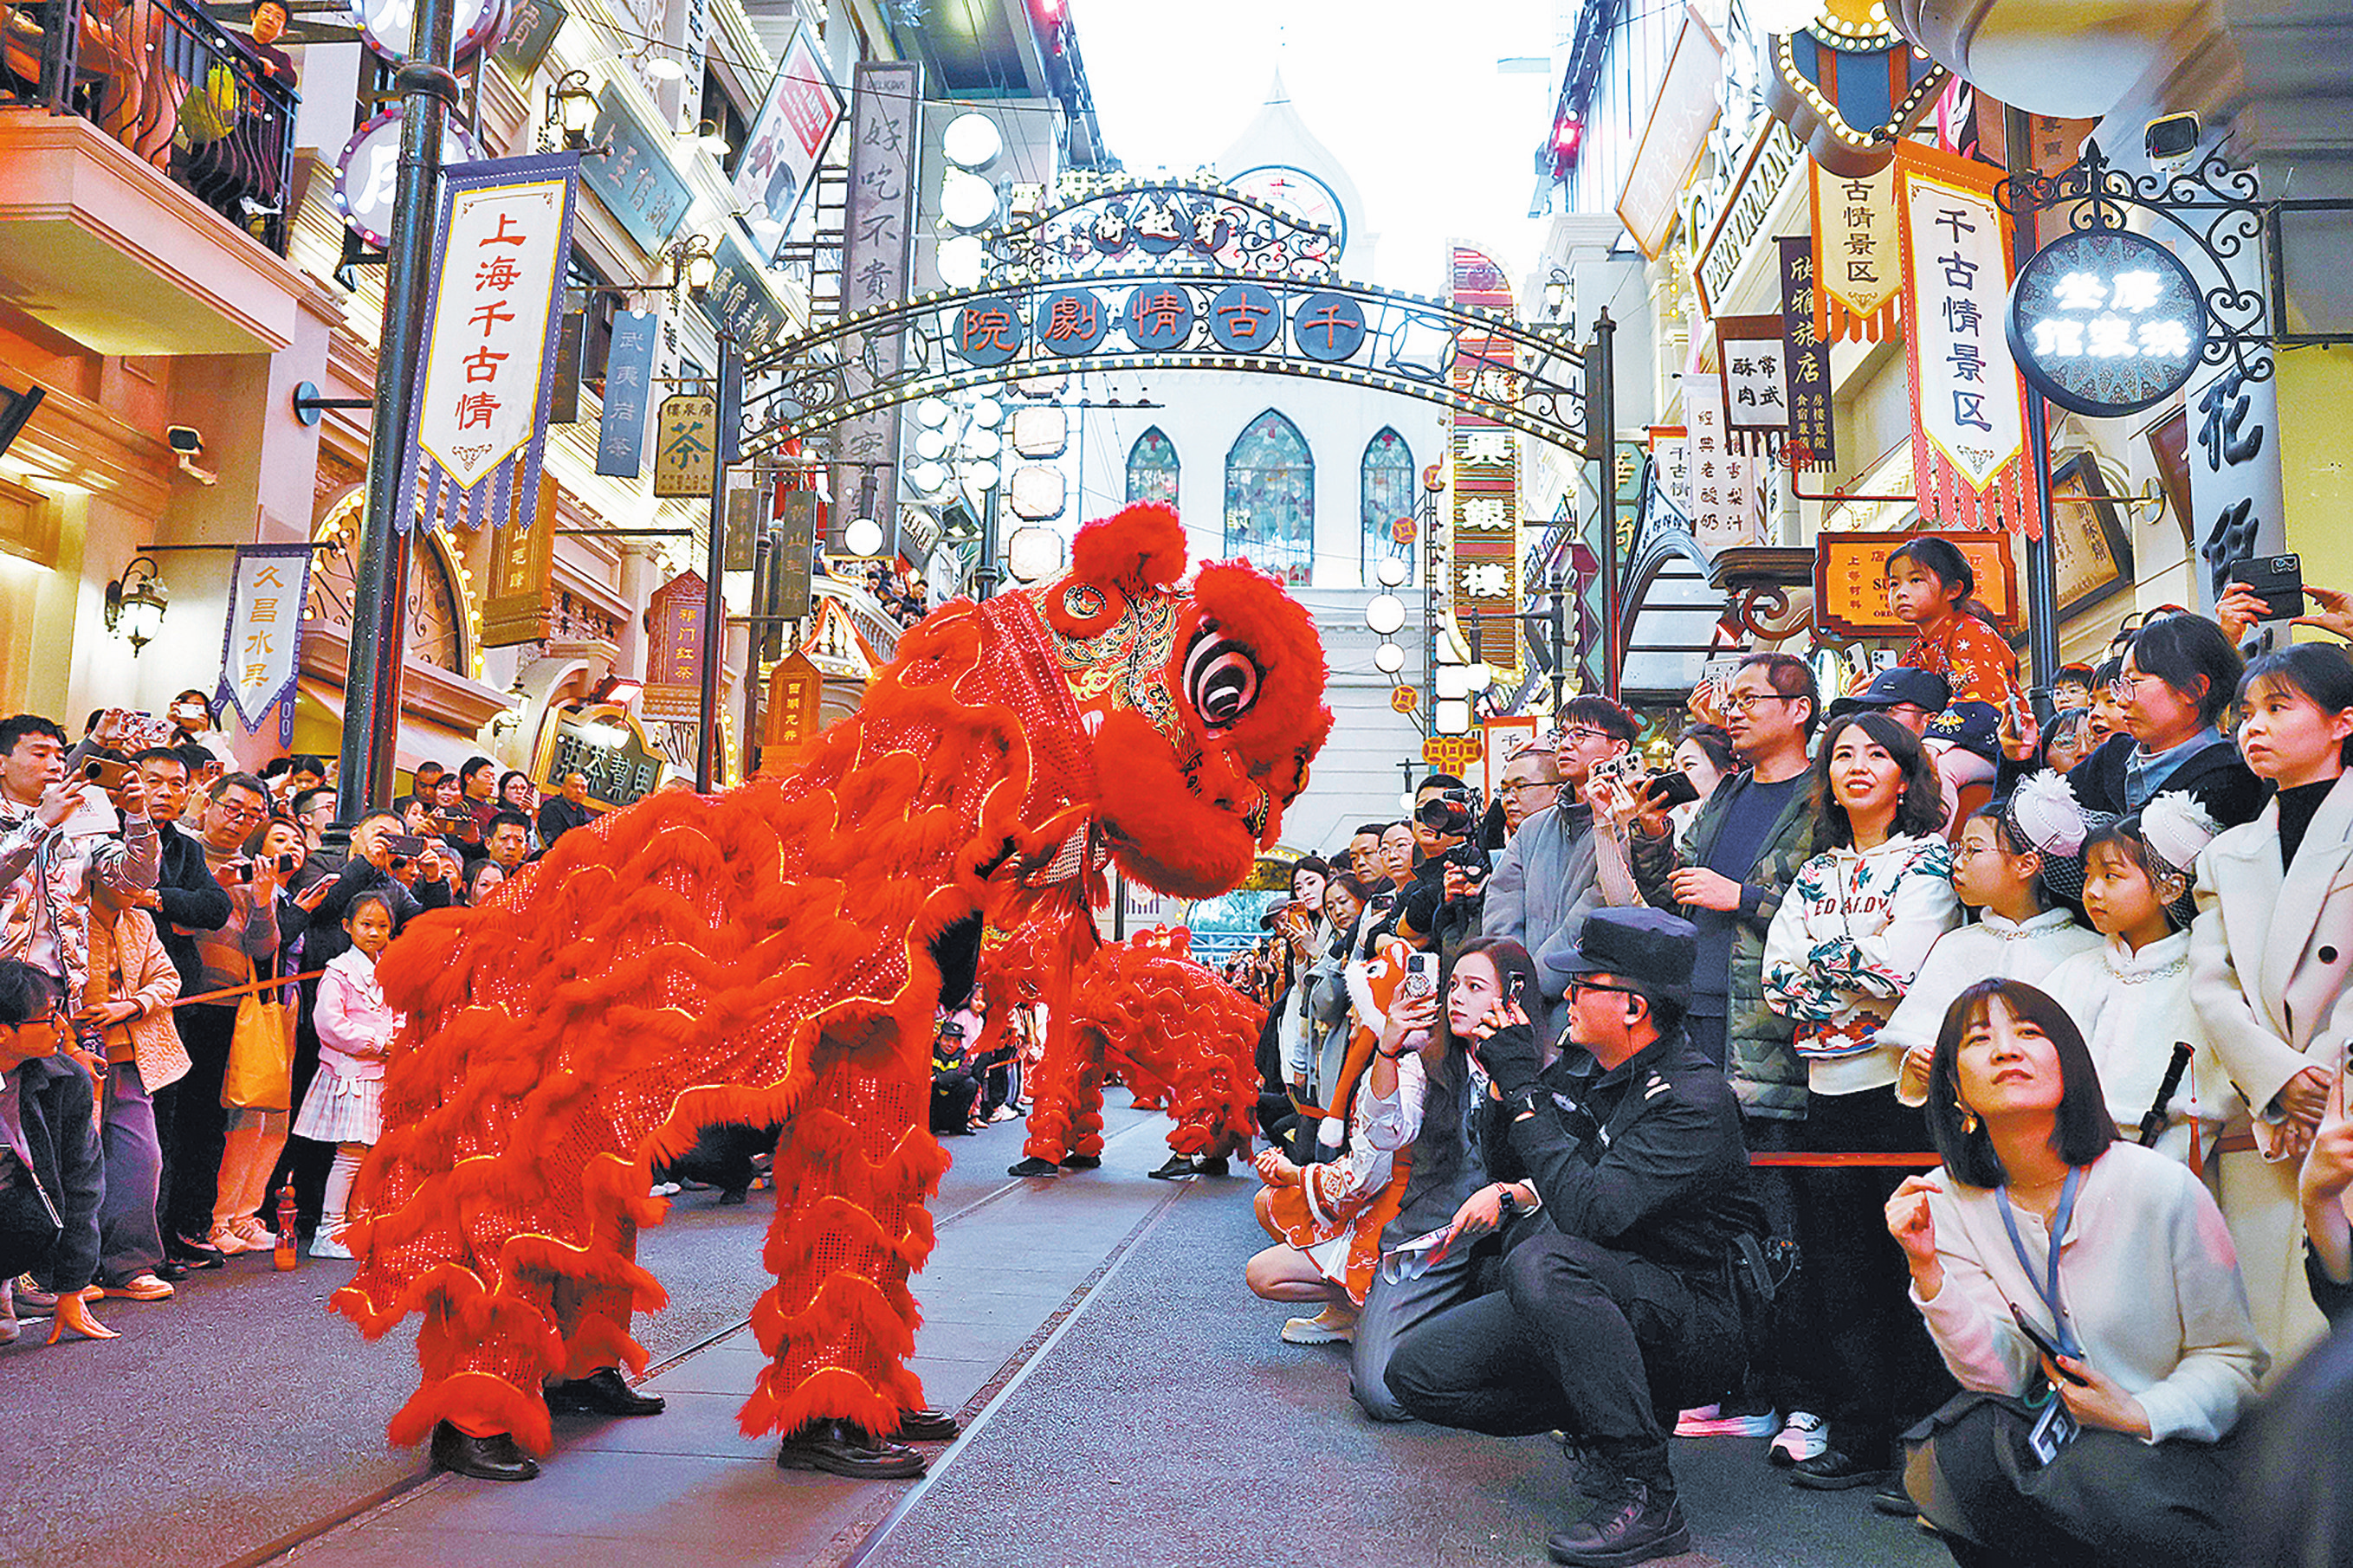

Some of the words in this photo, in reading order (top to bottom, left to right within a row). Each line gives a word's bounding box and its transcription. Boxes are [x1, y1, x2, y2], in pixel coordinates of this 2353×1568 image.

[456, 212, 526, 430] 上海千古情
[1935, 208, 1993, 432] 千古情景区
[606, 331, 644, 457] 武夷岩茶
[664, 421, 711, 470] 茶
[1698, 410, 1719, 530] 經典老酸奶
[509, 506, 528, 589] 山毛峰
[240, 565, 284, 687] 久昌水果
[675, 609, 697, 679] 祁门红茶
